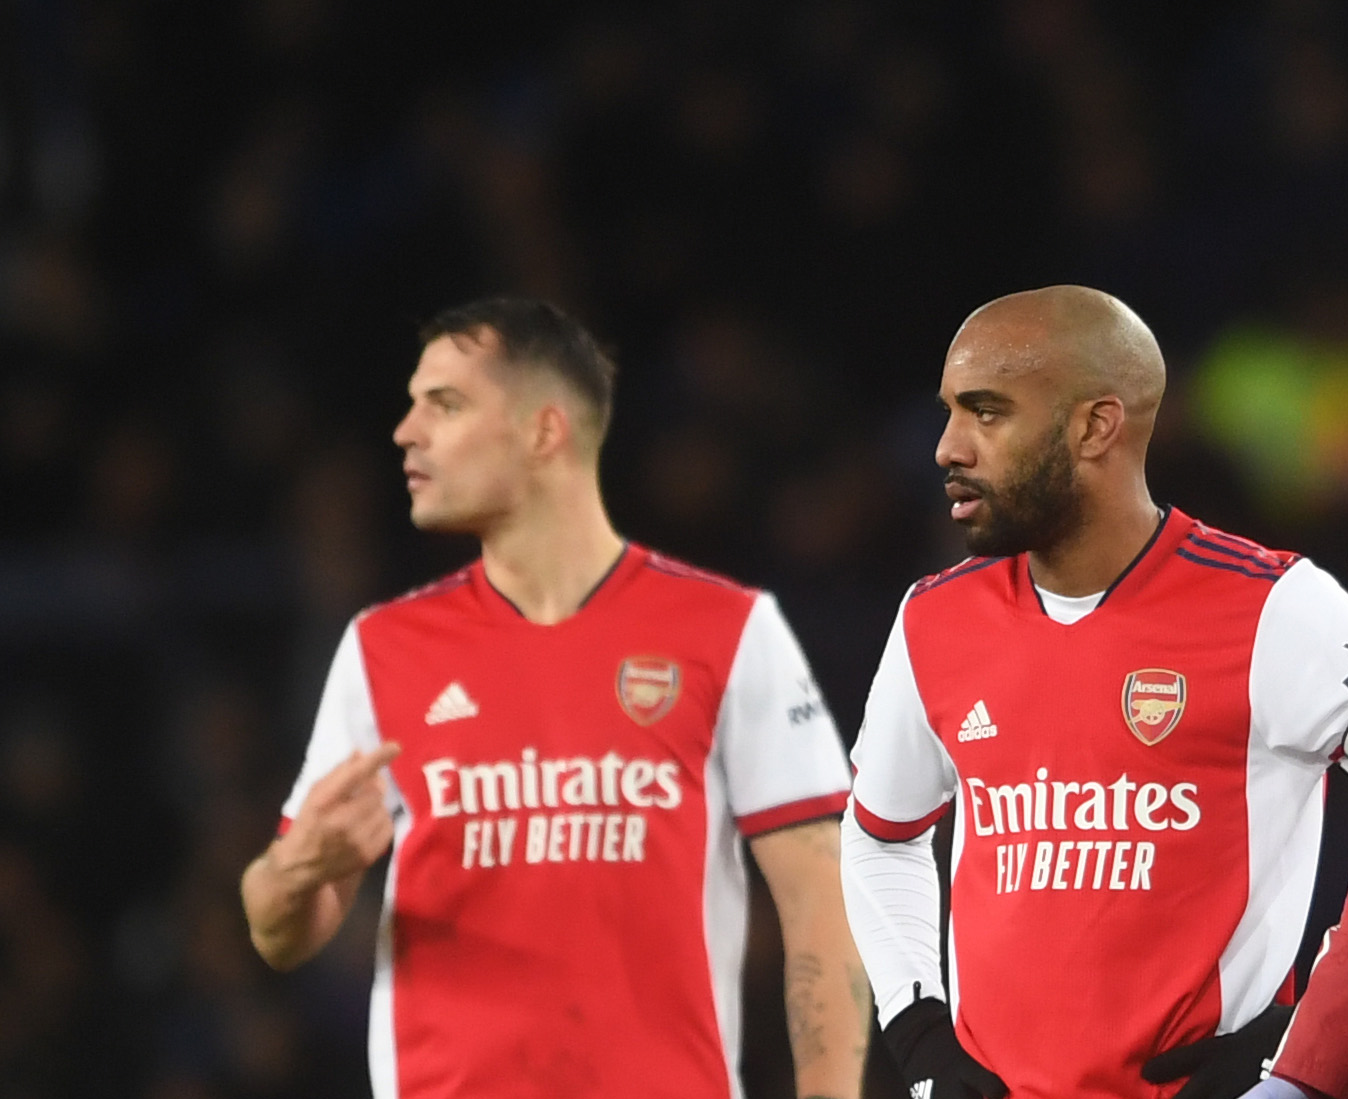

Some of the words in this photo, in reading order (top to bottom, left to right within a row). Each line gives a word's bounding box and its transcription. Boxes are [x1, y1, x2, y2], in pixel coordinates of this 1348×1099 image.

[1131, 680, 1179, 696] Arsenal
[957, 723, 998, 743] adidas
[422, 746, 683, 818] Emirates
[966, 766, 1202, 837] Emirates
[462, 816, 518, 870] FLY
[525, 812, 648, 865] BETTER
[996, 843, 1029, 895] FLY
[1030, 840, 1156, 891] BETTER
